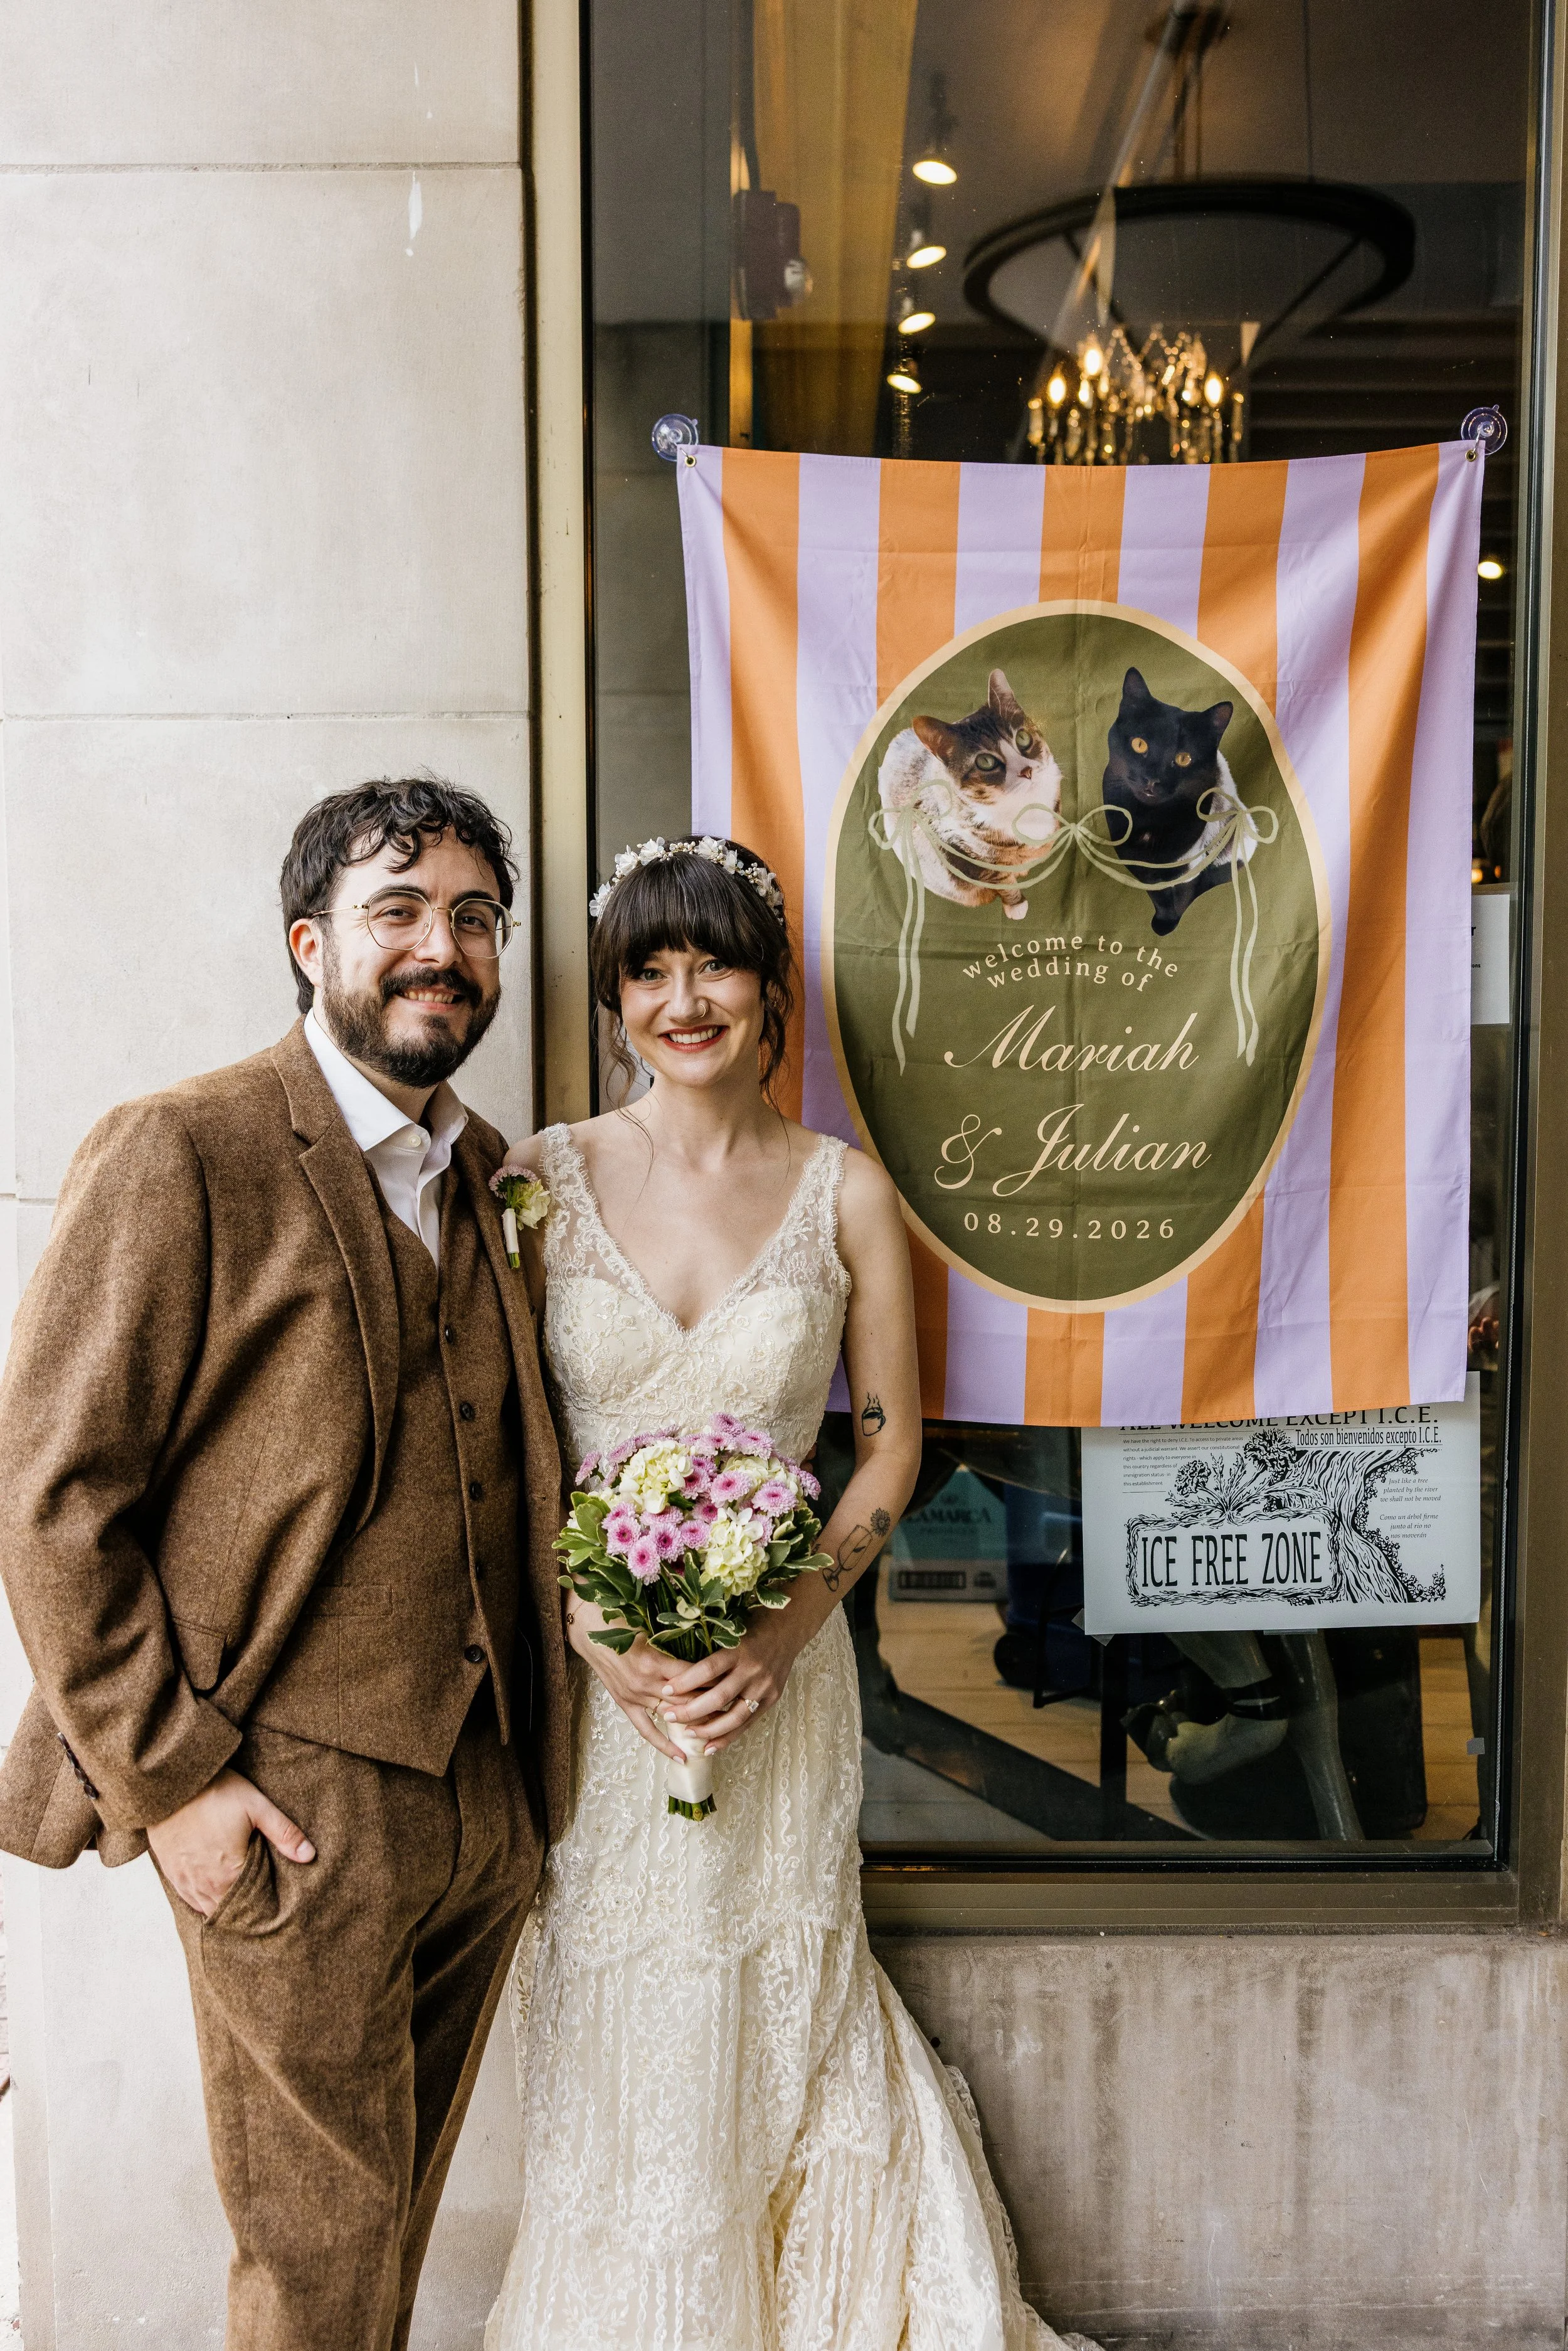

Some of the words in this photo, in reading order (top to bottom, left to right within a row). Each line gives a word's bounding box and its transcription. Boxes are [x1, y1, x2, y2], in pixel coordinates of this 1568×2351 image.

[963, 935, 1083, 979] welcome
[1099, 935, 1122, 955] to
[1136, 946, 1177, 977] the
[987, 957, 1109, 988] wedding
[1122, 972, 1153, 992] of
[943, 1004, 1199, 1072] Mariah
[934, 1113, 1002, 1190] &
[992, 1103, 1212, 1197] Julian
[964, 1212, 1174, 1239] 08.29.2026
[1379, 1406, 1438, 1423] I.C.E.
[1295, 1428, 1318, 1445] Todos
[1320, 1433, 1334, 1445] son
[1336, 1428, 1384, 1444] bienvenidos
[1386, 1429, 1417, 1448] excepto
[1419, 1426, 1441, 1443] I.C.E.
[1422, 1513, 1439, 1521] firme
[1142, 1536, 1178, 1587] ICE
[1192, 1534, 1249, 1586] FREE
[1261, 1531, 1322, 1584] ZONE
